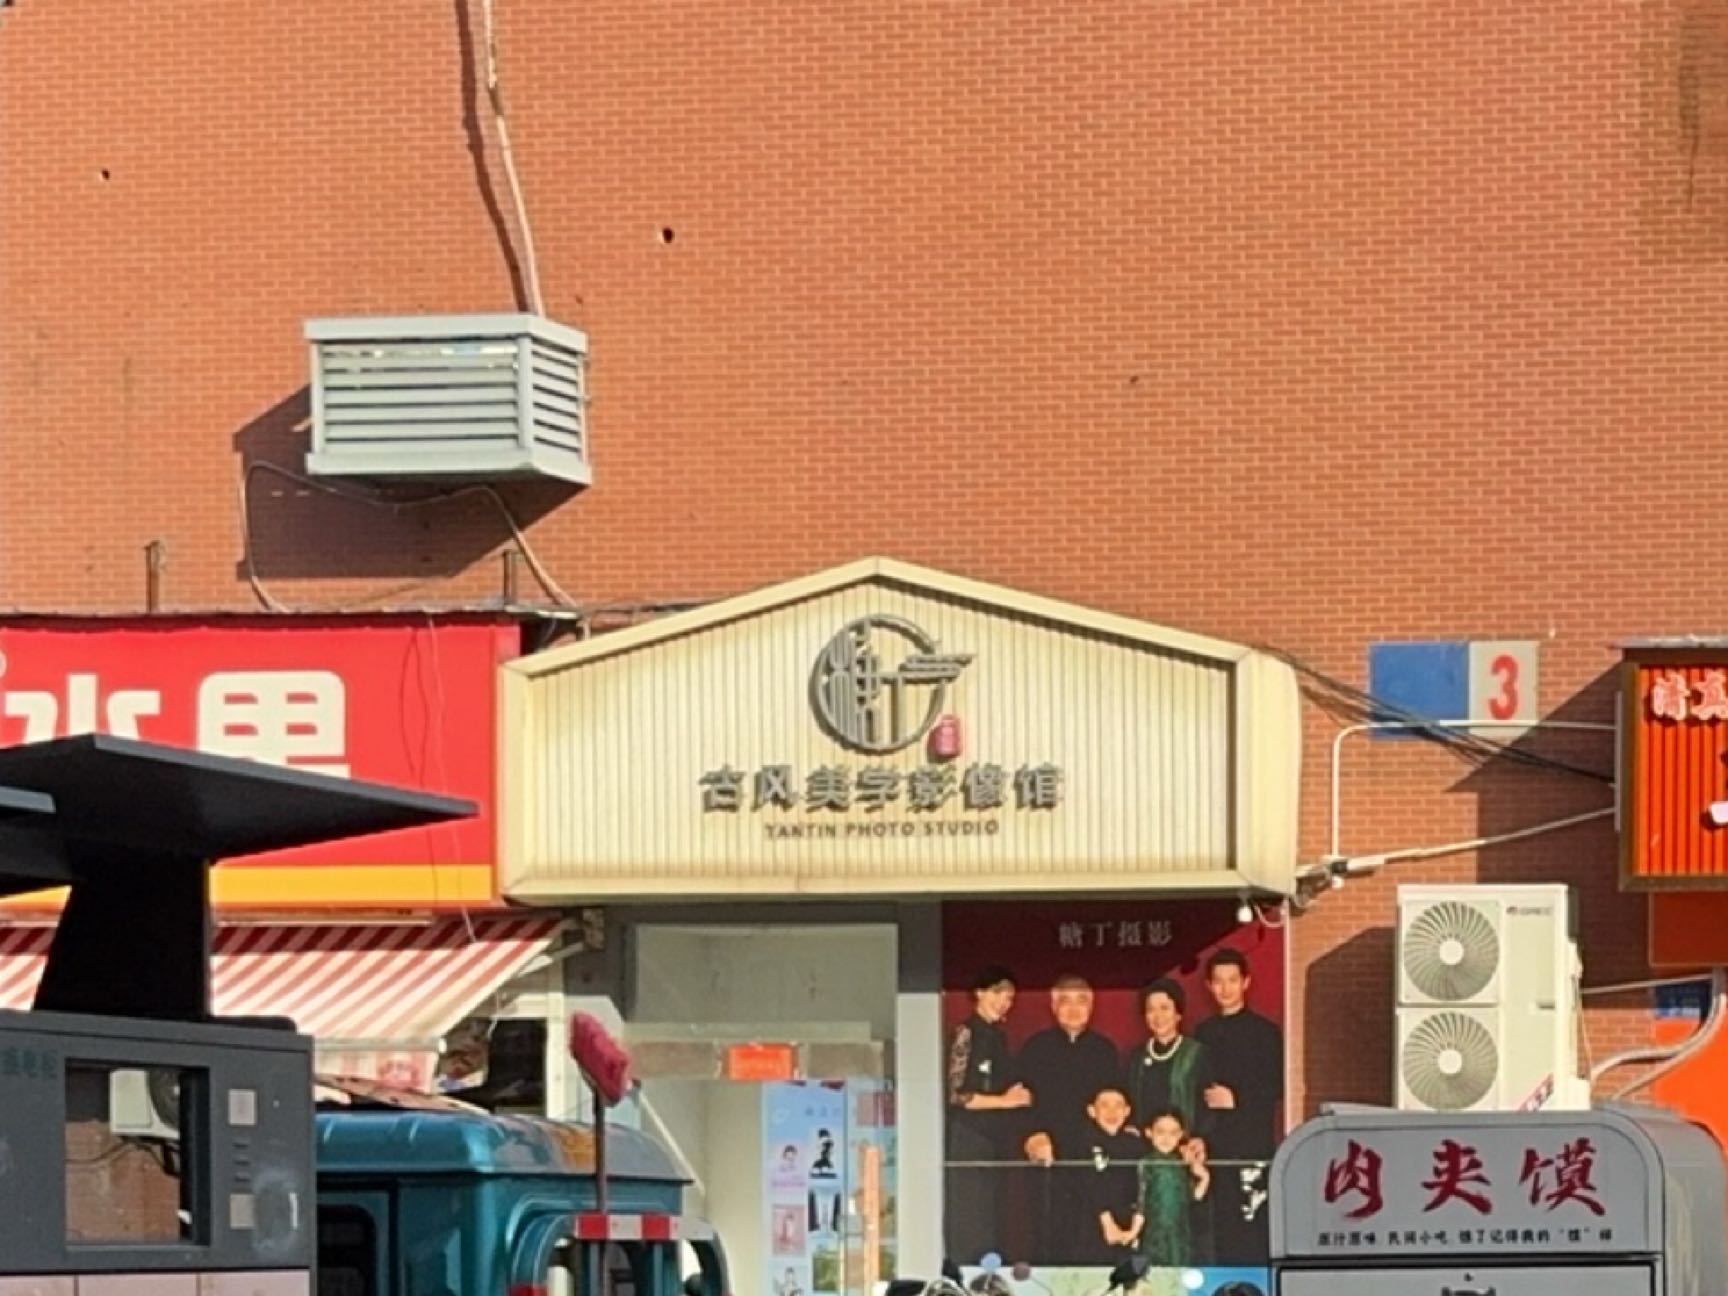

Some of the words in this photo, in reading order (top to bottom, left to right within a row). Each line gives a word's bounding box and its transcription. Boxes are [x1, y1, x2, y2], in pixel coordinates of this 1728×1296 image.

[1488, 654, 1518, 721] 3
[699, 762, 1066, 812] 古风美学影像馆
[847, 822, 916, 837] PHOTO
[923, 819, 999, 836] STUDIO
[1324, 1137, 1606, 1220] 肉夹馍
